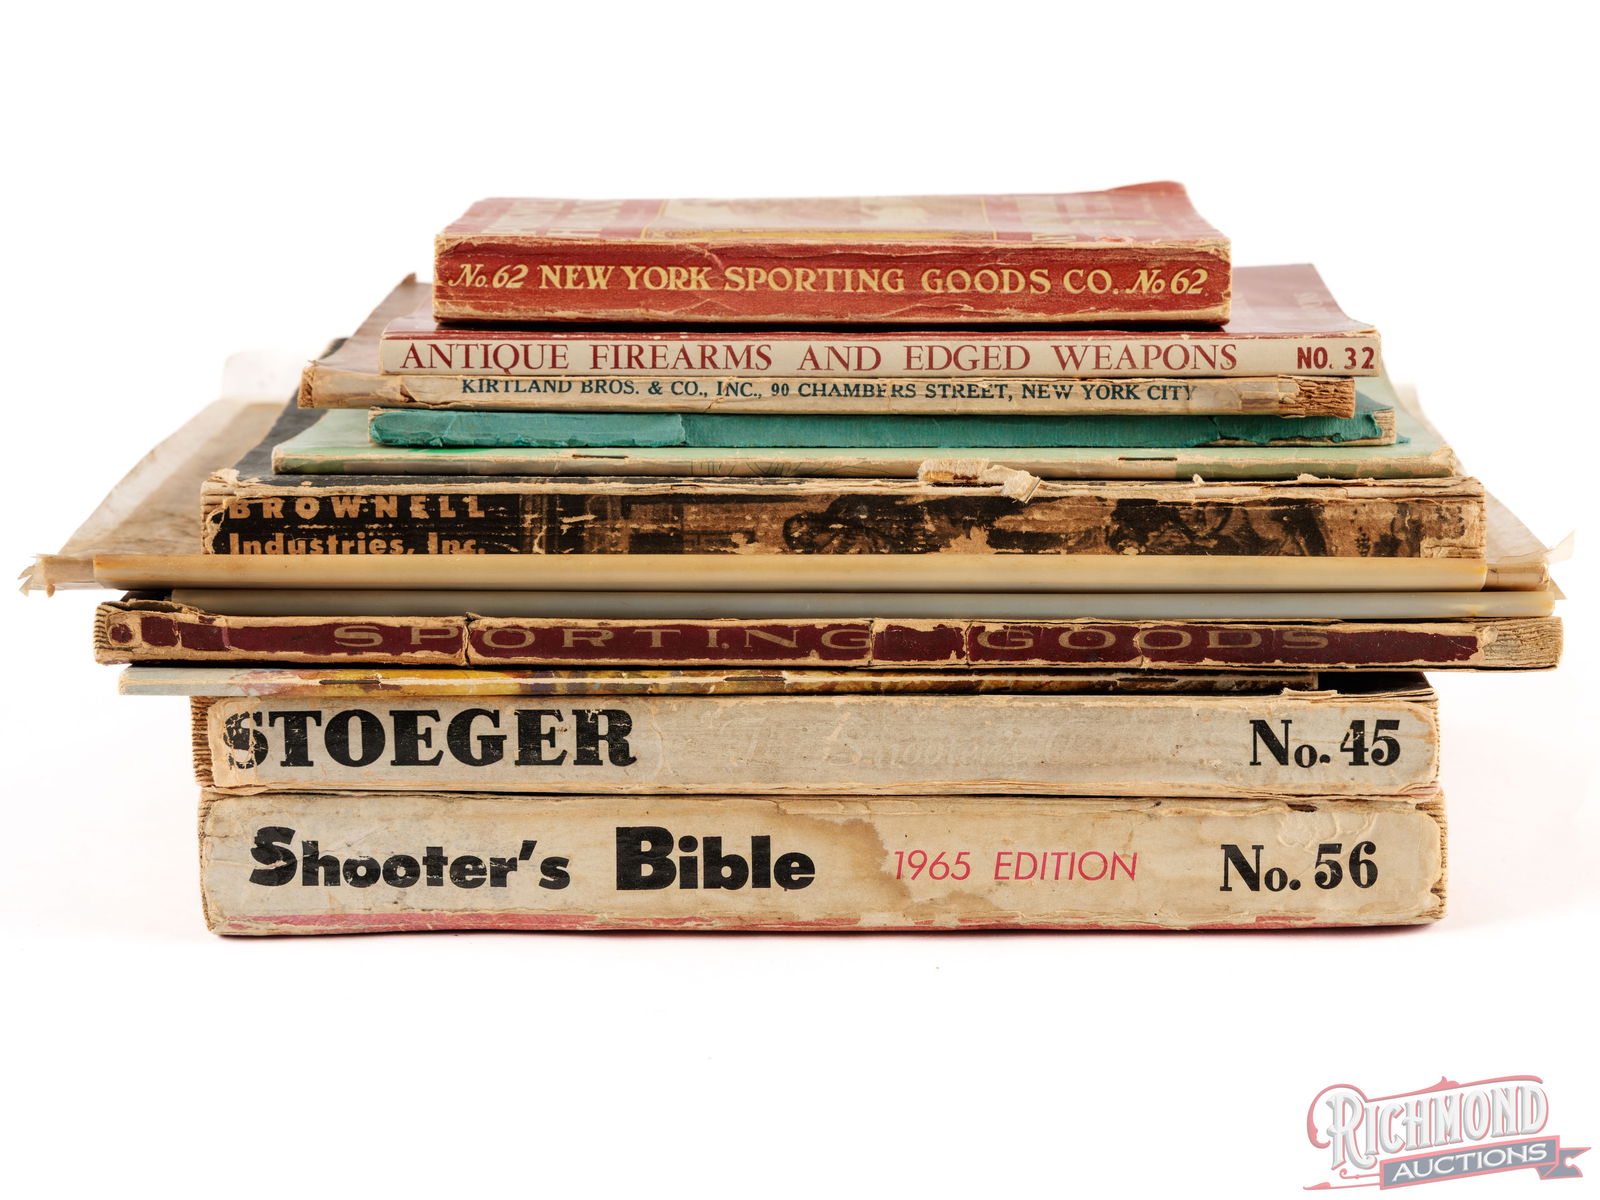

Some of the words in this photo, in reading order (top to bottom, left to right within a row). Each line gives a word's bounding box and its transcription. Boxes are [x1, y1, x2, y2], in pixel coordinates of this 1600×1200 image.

[491, 264, 529, 289] 62
[538, 265, 613, 290] NEW
[619, 265, 712, 290] YORK
[723, 266, 905, 294] SPORTING
[921, 268, 1051, 295] GOODS
[1063, 269, 1121, 296] CO.
[1170, 269, 1209, 295] 62
[402, 343, 569, 375] ANTIQUE
[590, 344, 773, 371] FIREARMS
[797, 345, 882, 372] AND
[905, 345, 1031, 372] EDGED
[1056, 343, 1238, 371] WEAPONS
[1297, 347, 1335, 369] NO.
[1344, 346, 1375, 370] 32
[461, 378, 573, 394] KIRTLAND
[580, 379, 640, 395] BROS.
[648, 380, 664, 395] &
[670, 381, 708, 398] CO.,
[716, 381, 763, 399] INC.,
[771, 383, 790, 397] 90
[797, 383, 917, 398] CHAMBERS
[925, 384, 1014, 401] STREET,
[1022, 384, 1074, 400] NEW
[1082, 384, 1142, 400] YORK
[1147, 384, 1199, 401] CITY
[229, 496, 486, 519] BROWNELL
[229, 532, 416, 554] Industries,
[428, 532, 487, 554] Inc.
[977, 629, 1329, 650] GOODS
[223, 709, 637, 768] STOEGER
[1250, 720, 1330, 768] No.
[1340, 719, 1401, 766] 45
[249, 826, 571, 890] Shooter's
[616, 826, 816, 892] Bible
[895, 850, 971, 881] 1965
[994, 851, 1138, 881] EDITION
[1220, 844, 1301, 892] No.
[1314, 841, 1378, 889] 56
